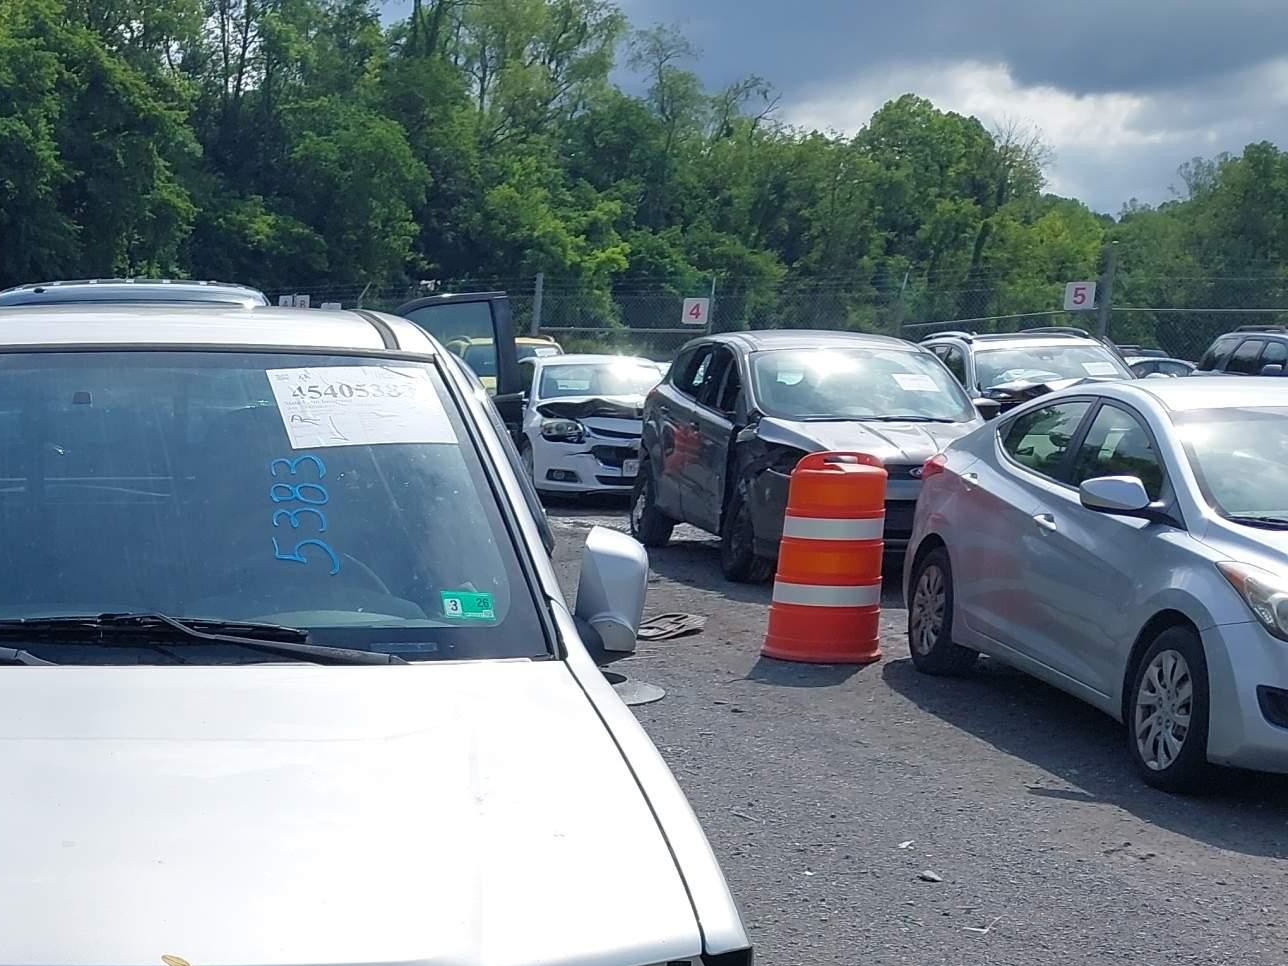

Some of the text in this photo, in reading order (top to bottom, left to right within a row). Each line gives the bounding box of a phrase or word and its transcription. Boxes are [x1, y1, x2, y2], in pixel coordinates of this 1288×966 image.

[1073, 287, 1086, 305] 5
[689, 303, 701, 319] 4
[271, 454, 341, 576] 5383
[449, 597, 490, 612] 3 26
